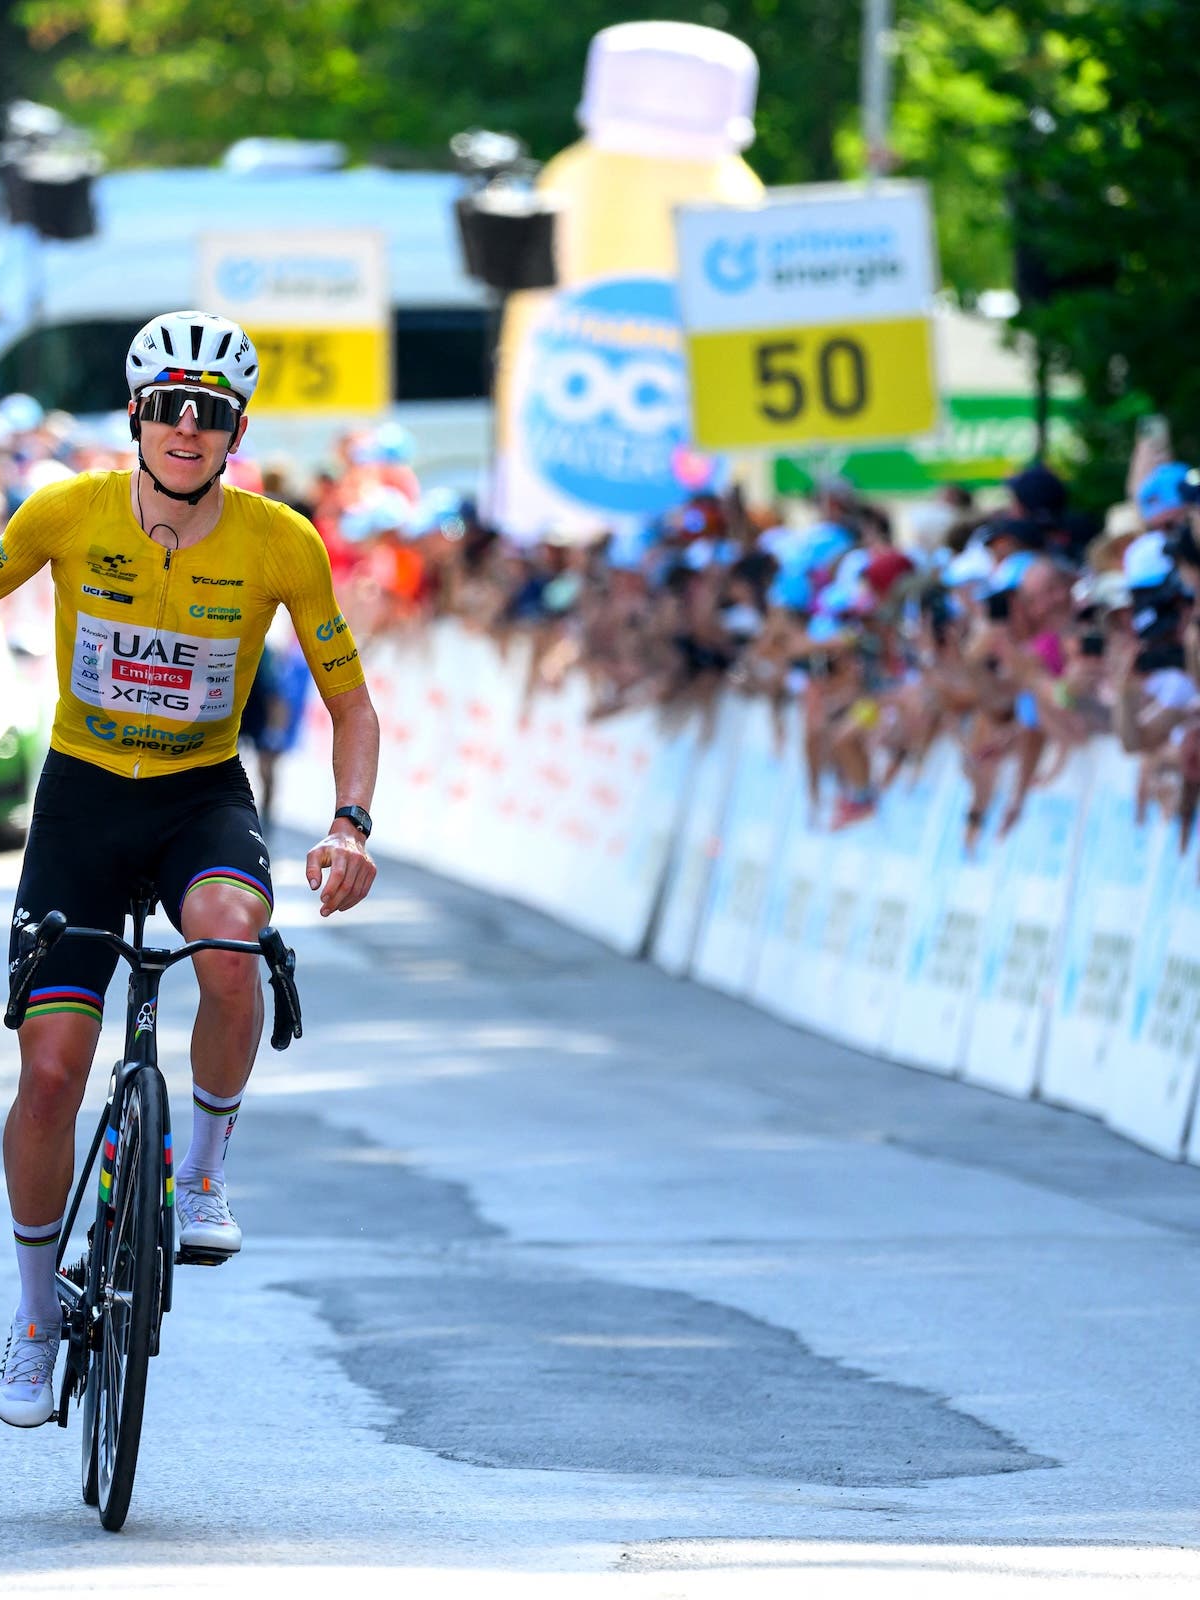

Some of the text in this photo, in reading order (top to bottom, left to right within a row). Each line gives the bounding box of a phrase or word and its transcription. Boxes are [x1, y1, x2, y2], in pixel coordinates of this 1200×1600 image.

[257, 336, 339, 401] 75
[755, 334, 870, 425] 50
[82, 584, 101, 597] UCI
[201, 578, 244, 587] CUORE
[207, 613, 242, 623] energie
[82, 640, 97, 651] FAB
[112, 631, 199, 667] UAE
[118, 664, 184, 684] Emirates
[214, 675, 231, 684] IHC
[111, 684, 190, 712] XRG
[122, 724, 206, 744] primeo
[120, 737, 205, 756] energie
